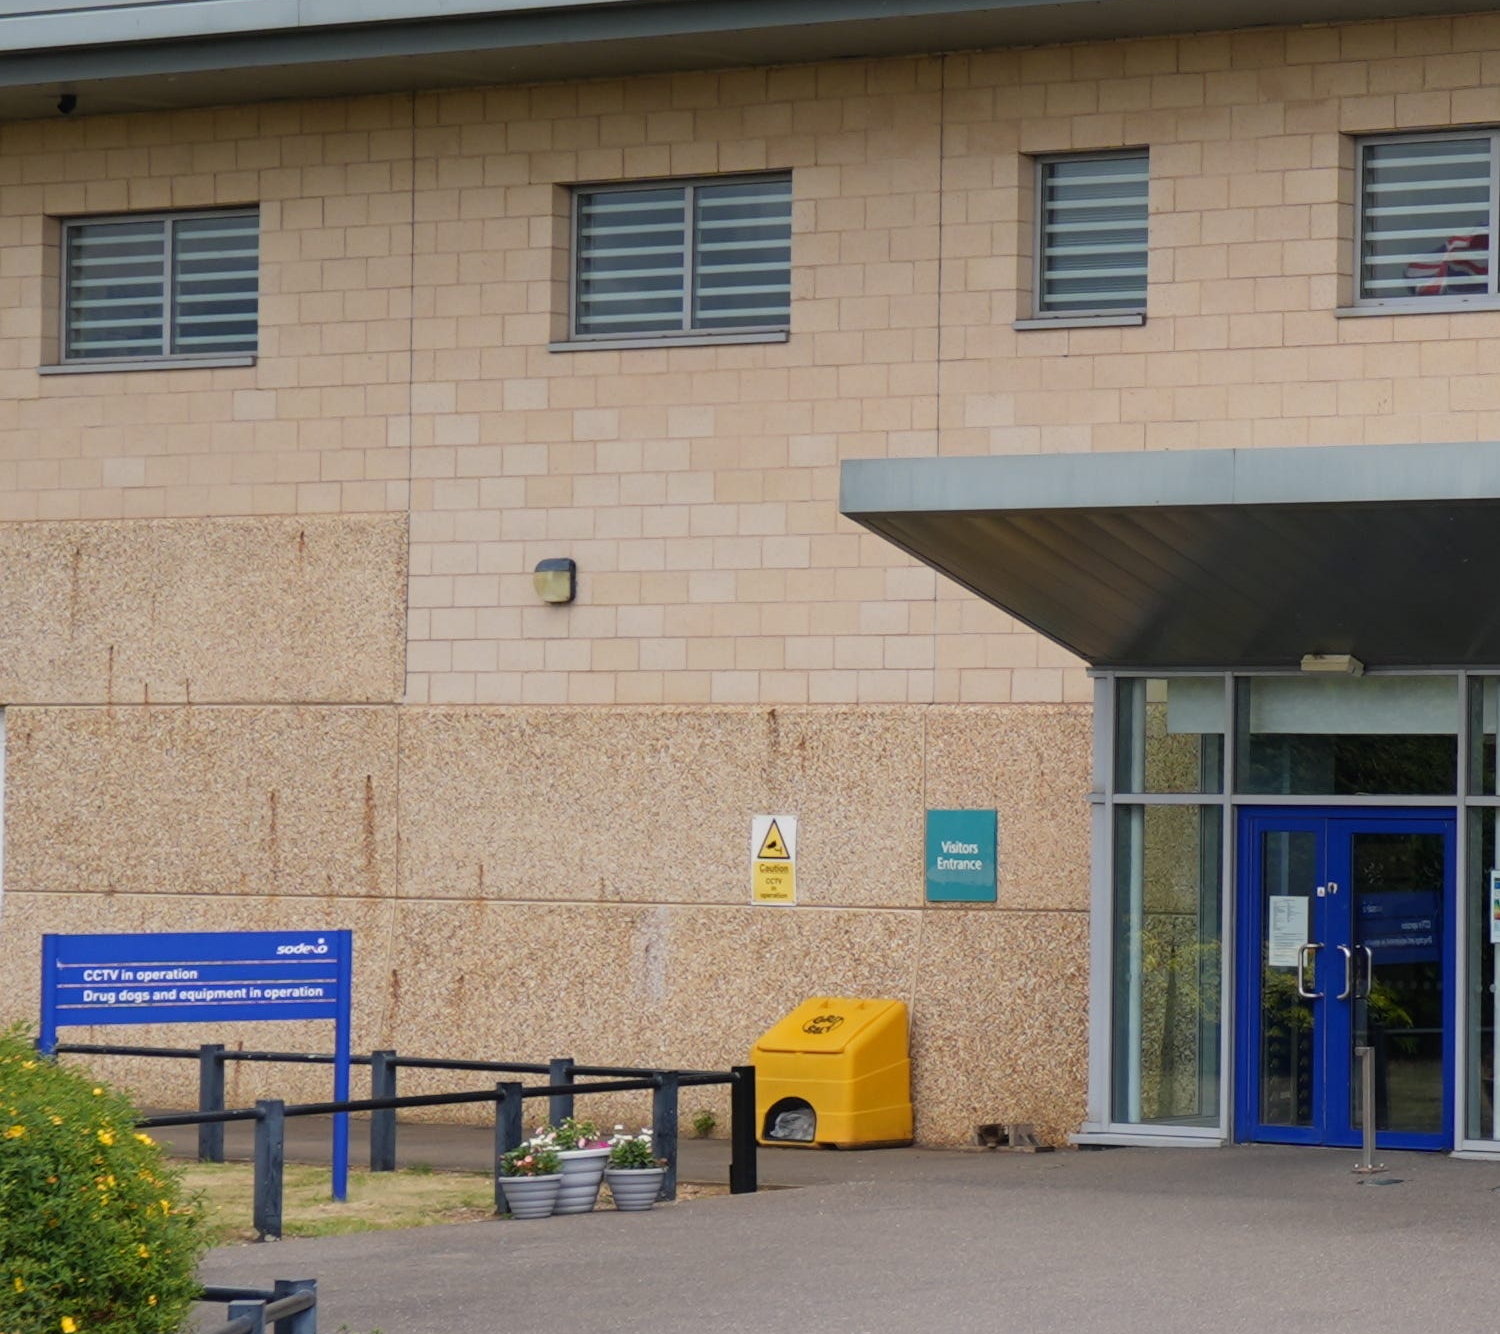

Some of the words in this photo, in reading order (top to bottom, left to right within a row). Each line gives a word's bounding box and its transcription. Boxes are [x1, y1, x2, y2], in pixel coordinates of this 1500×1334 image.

[941, 841, 979, 854] Visitors
[760, 863, 789, 873] Caution
[937, 856, 983, 870] Entrance
[765, 877, 782, 885] CCTV
[276, 942, 328, 955] sodexo
[83, 969, 120, 982] CCTV
[121, 969, 133, 981] in
[136, 968, 198, 983] operation
[83, 989, 116, 1004] Drug
[118, 988, 150, 1004] dogs
[152, 987, 177, 1001] and
[179, 987, 247, 1003] equipment
[250, 986, 262, 999] in
[263, 985, 323, 1001] operation
